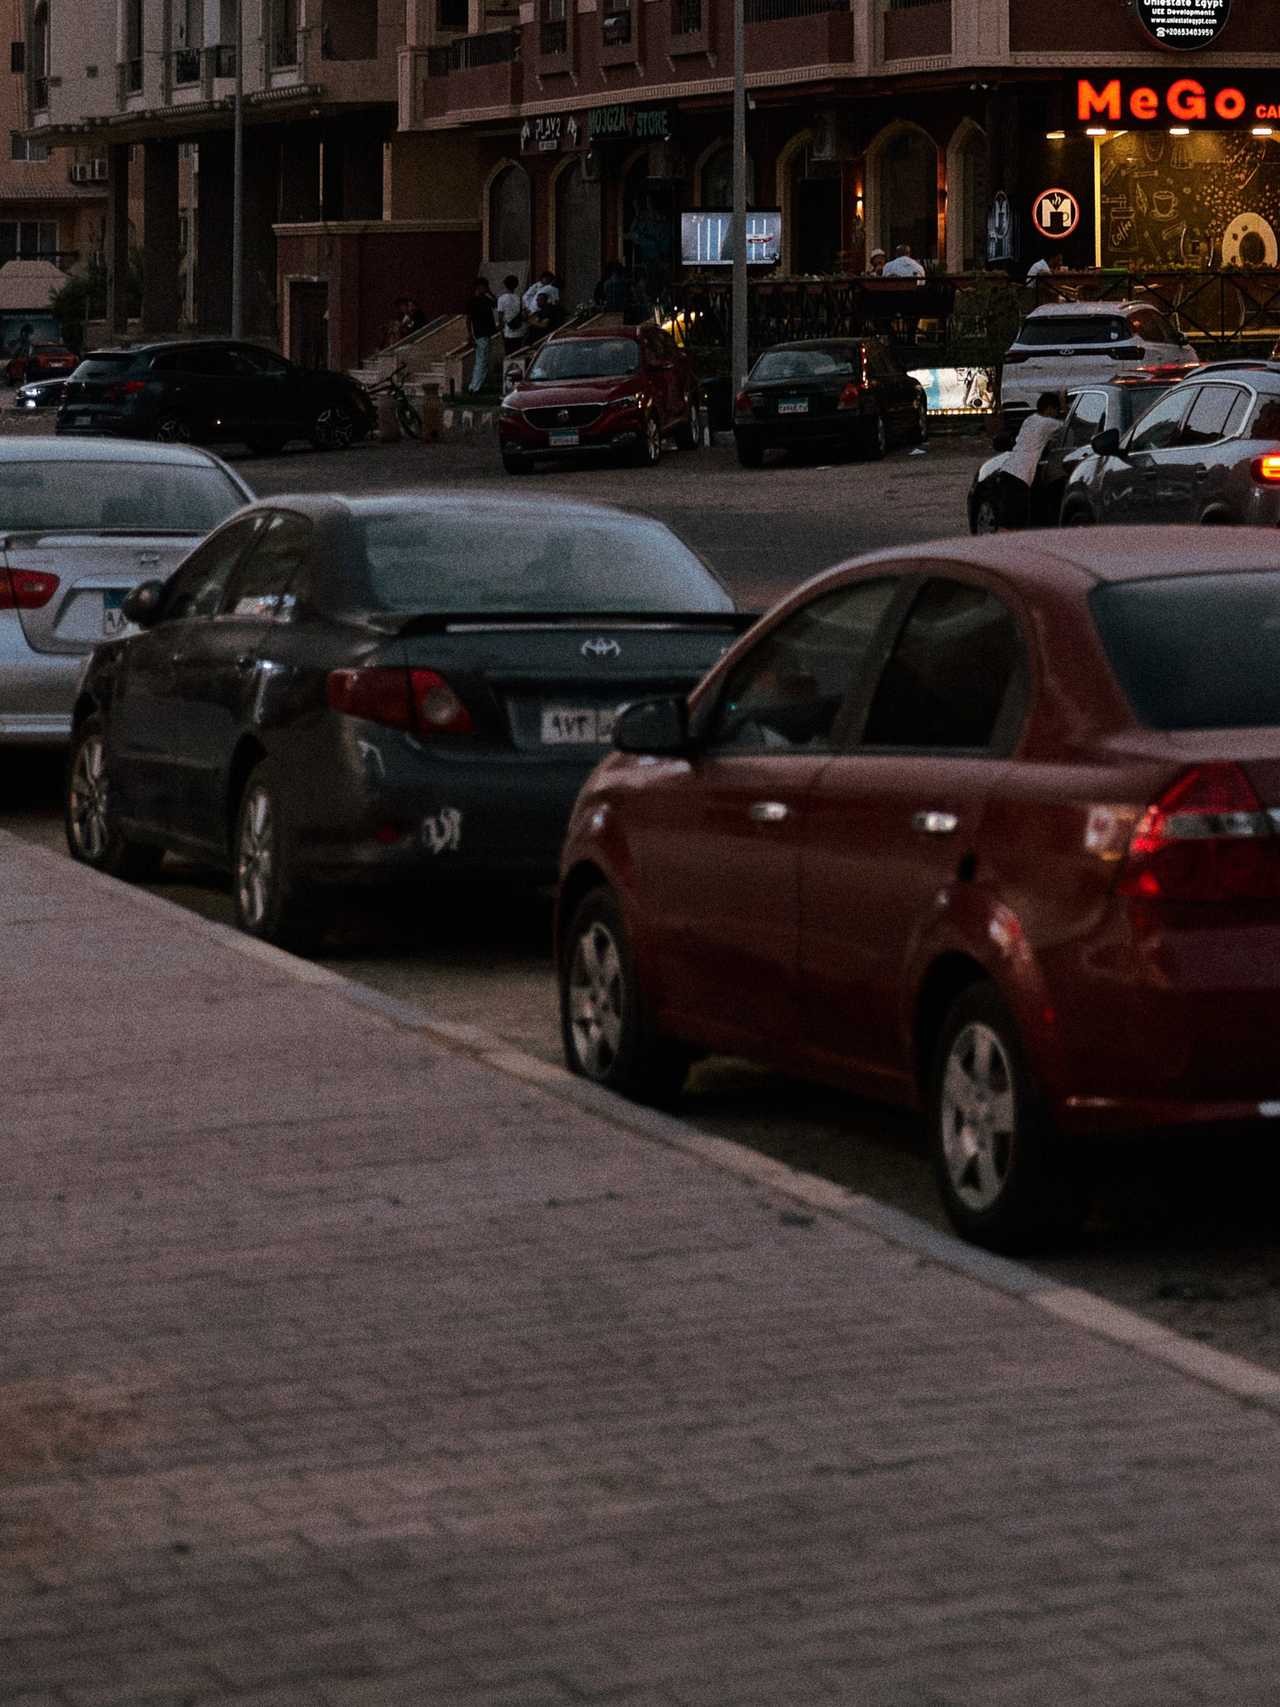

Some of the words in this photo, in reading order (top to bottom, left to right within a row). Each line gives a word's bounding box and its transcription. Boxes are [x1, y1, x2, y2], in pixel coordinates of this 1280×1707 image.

[1166, 8, 1215, 17] Developments
[1078, 79, 1246, 120] MeGo
[636, 110, 669, 137] STORE
